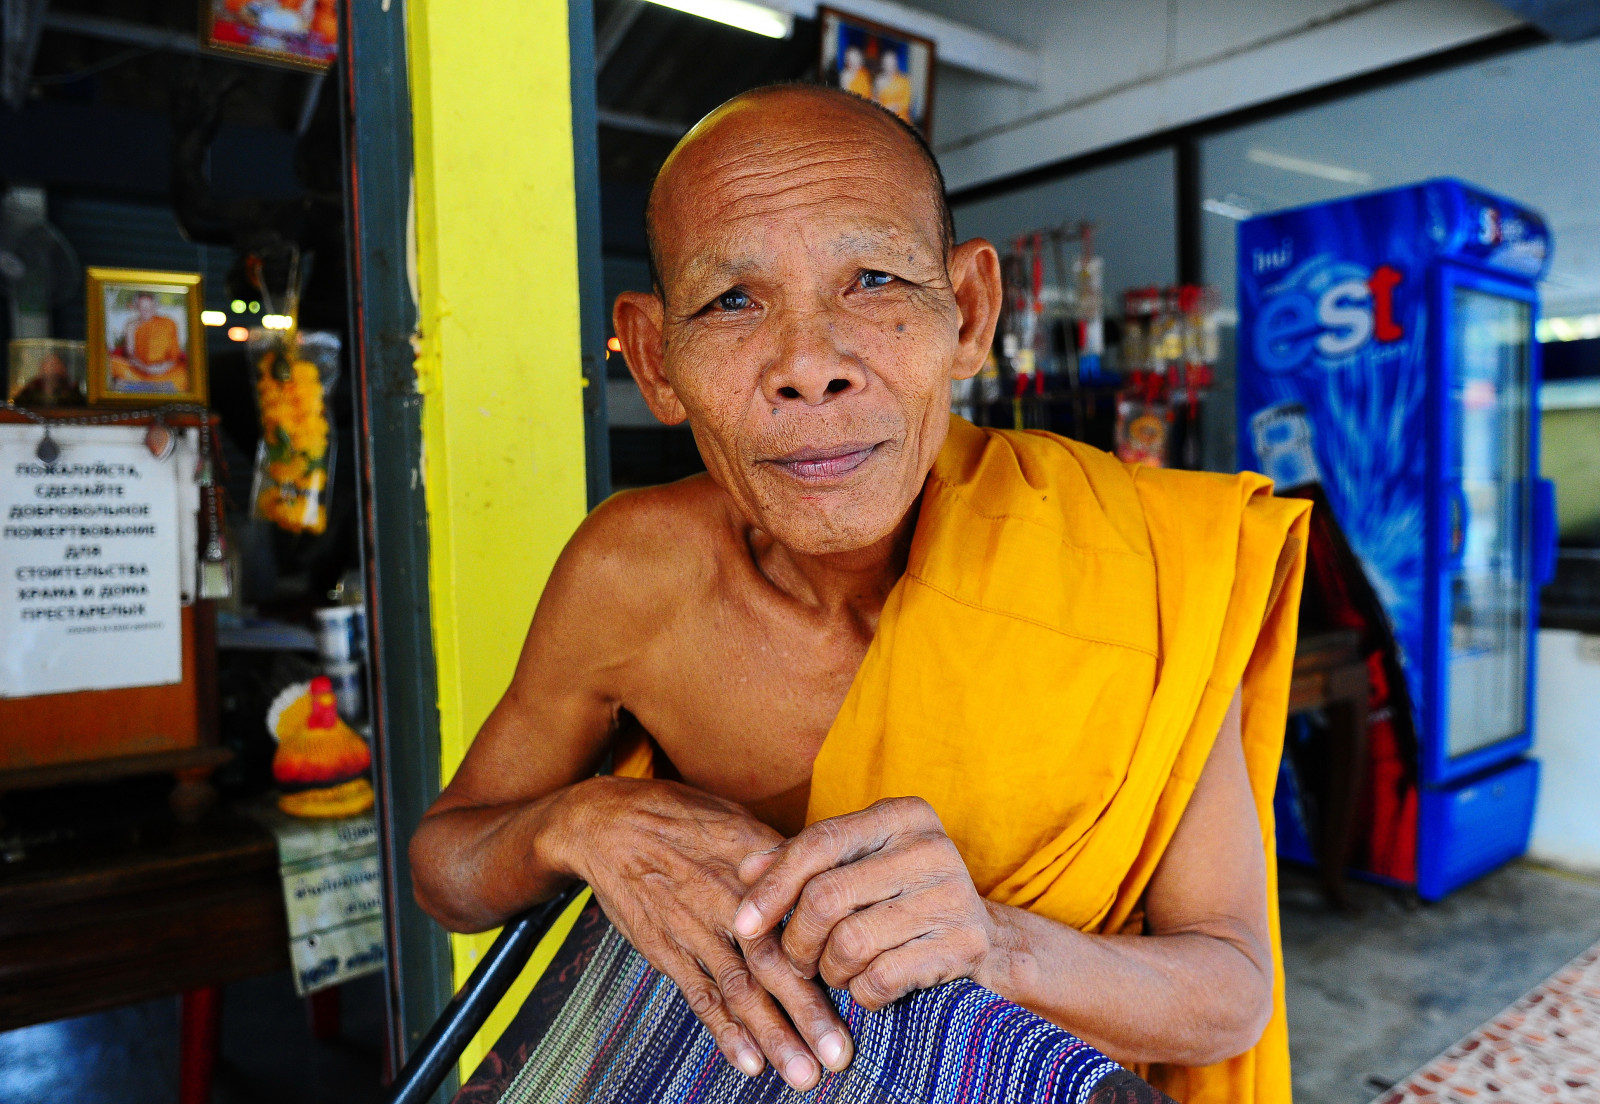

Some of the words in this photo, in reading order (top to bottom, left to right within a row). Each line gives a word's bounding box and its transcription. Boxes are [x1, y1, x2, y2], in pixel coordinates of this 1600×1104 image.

[1254, 264, 1404, 371] est
[35, 482, 125, 498] СДЕЛАЙТЕ
[9, 503, 150, 519] ДОБРОВОЛЬНОЕ
[4, 524, 156, 539] ПОЖЕРТВОВАНИЕ
[64, 545, 101, 559] ДЛЯ
[18, 585, 76, 600] ХРАМА
[99, 583, 148, 598] ДОМА
[22, 603, 145, 620] ПРЕСТАРЕЛЫХ
